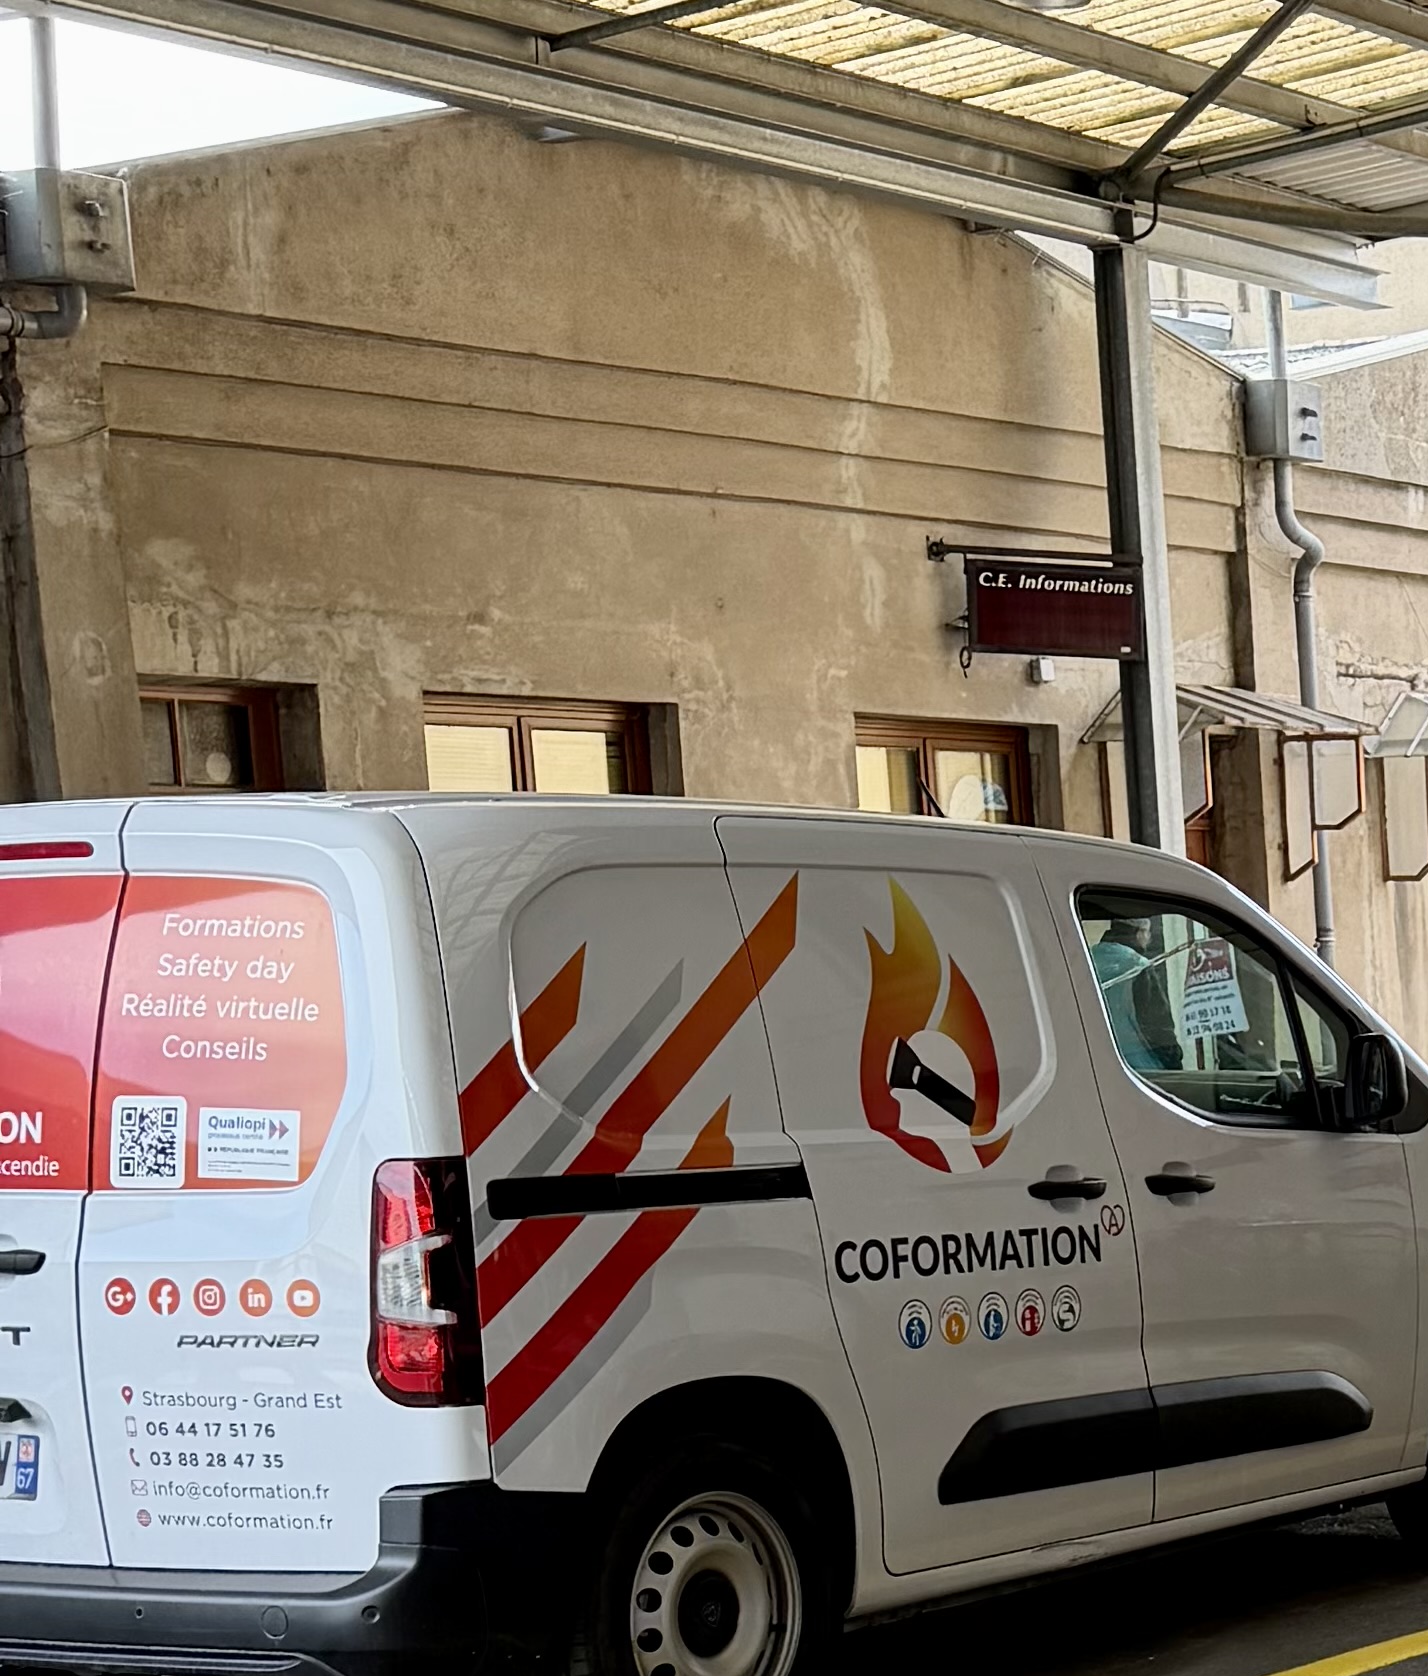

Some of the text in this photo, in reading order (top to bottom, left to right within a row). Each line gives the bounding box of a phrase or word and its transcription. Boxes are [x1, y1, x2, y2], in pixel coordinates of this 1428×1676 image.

[978, 572, 1135, 595] C.E. Informations
[161, 913, 305, 939] Formations
[156, 953, 295, 984] Safety day
[120, 992, 320, 1022] Réalité virtuelle
[161, 1035, 268, 1062] Conseils
[0, 1111, 43, 1144] ON
[207, 1115, 267, 1132] Qualiopi
[833, 1223, 1103, 1285] COFORMATION
[176, 1334, 320, 1349] PARTNER
[142, 1390, 238, 1411] Strasbourg
[253, 1392, 308, 1409] Grand
[314, 1393, 343, 1409] Est
[145, 1421, 276, 1438] 06 44 17 51 76
[149, 1451, 284, 1469] 03 88 28 47 35
[16, 1467, 34, 1490] 67
[152, 1480, 330, 1500] info@coformation.fr
[157, 1512, 333, 1530] www.coformation.fr
